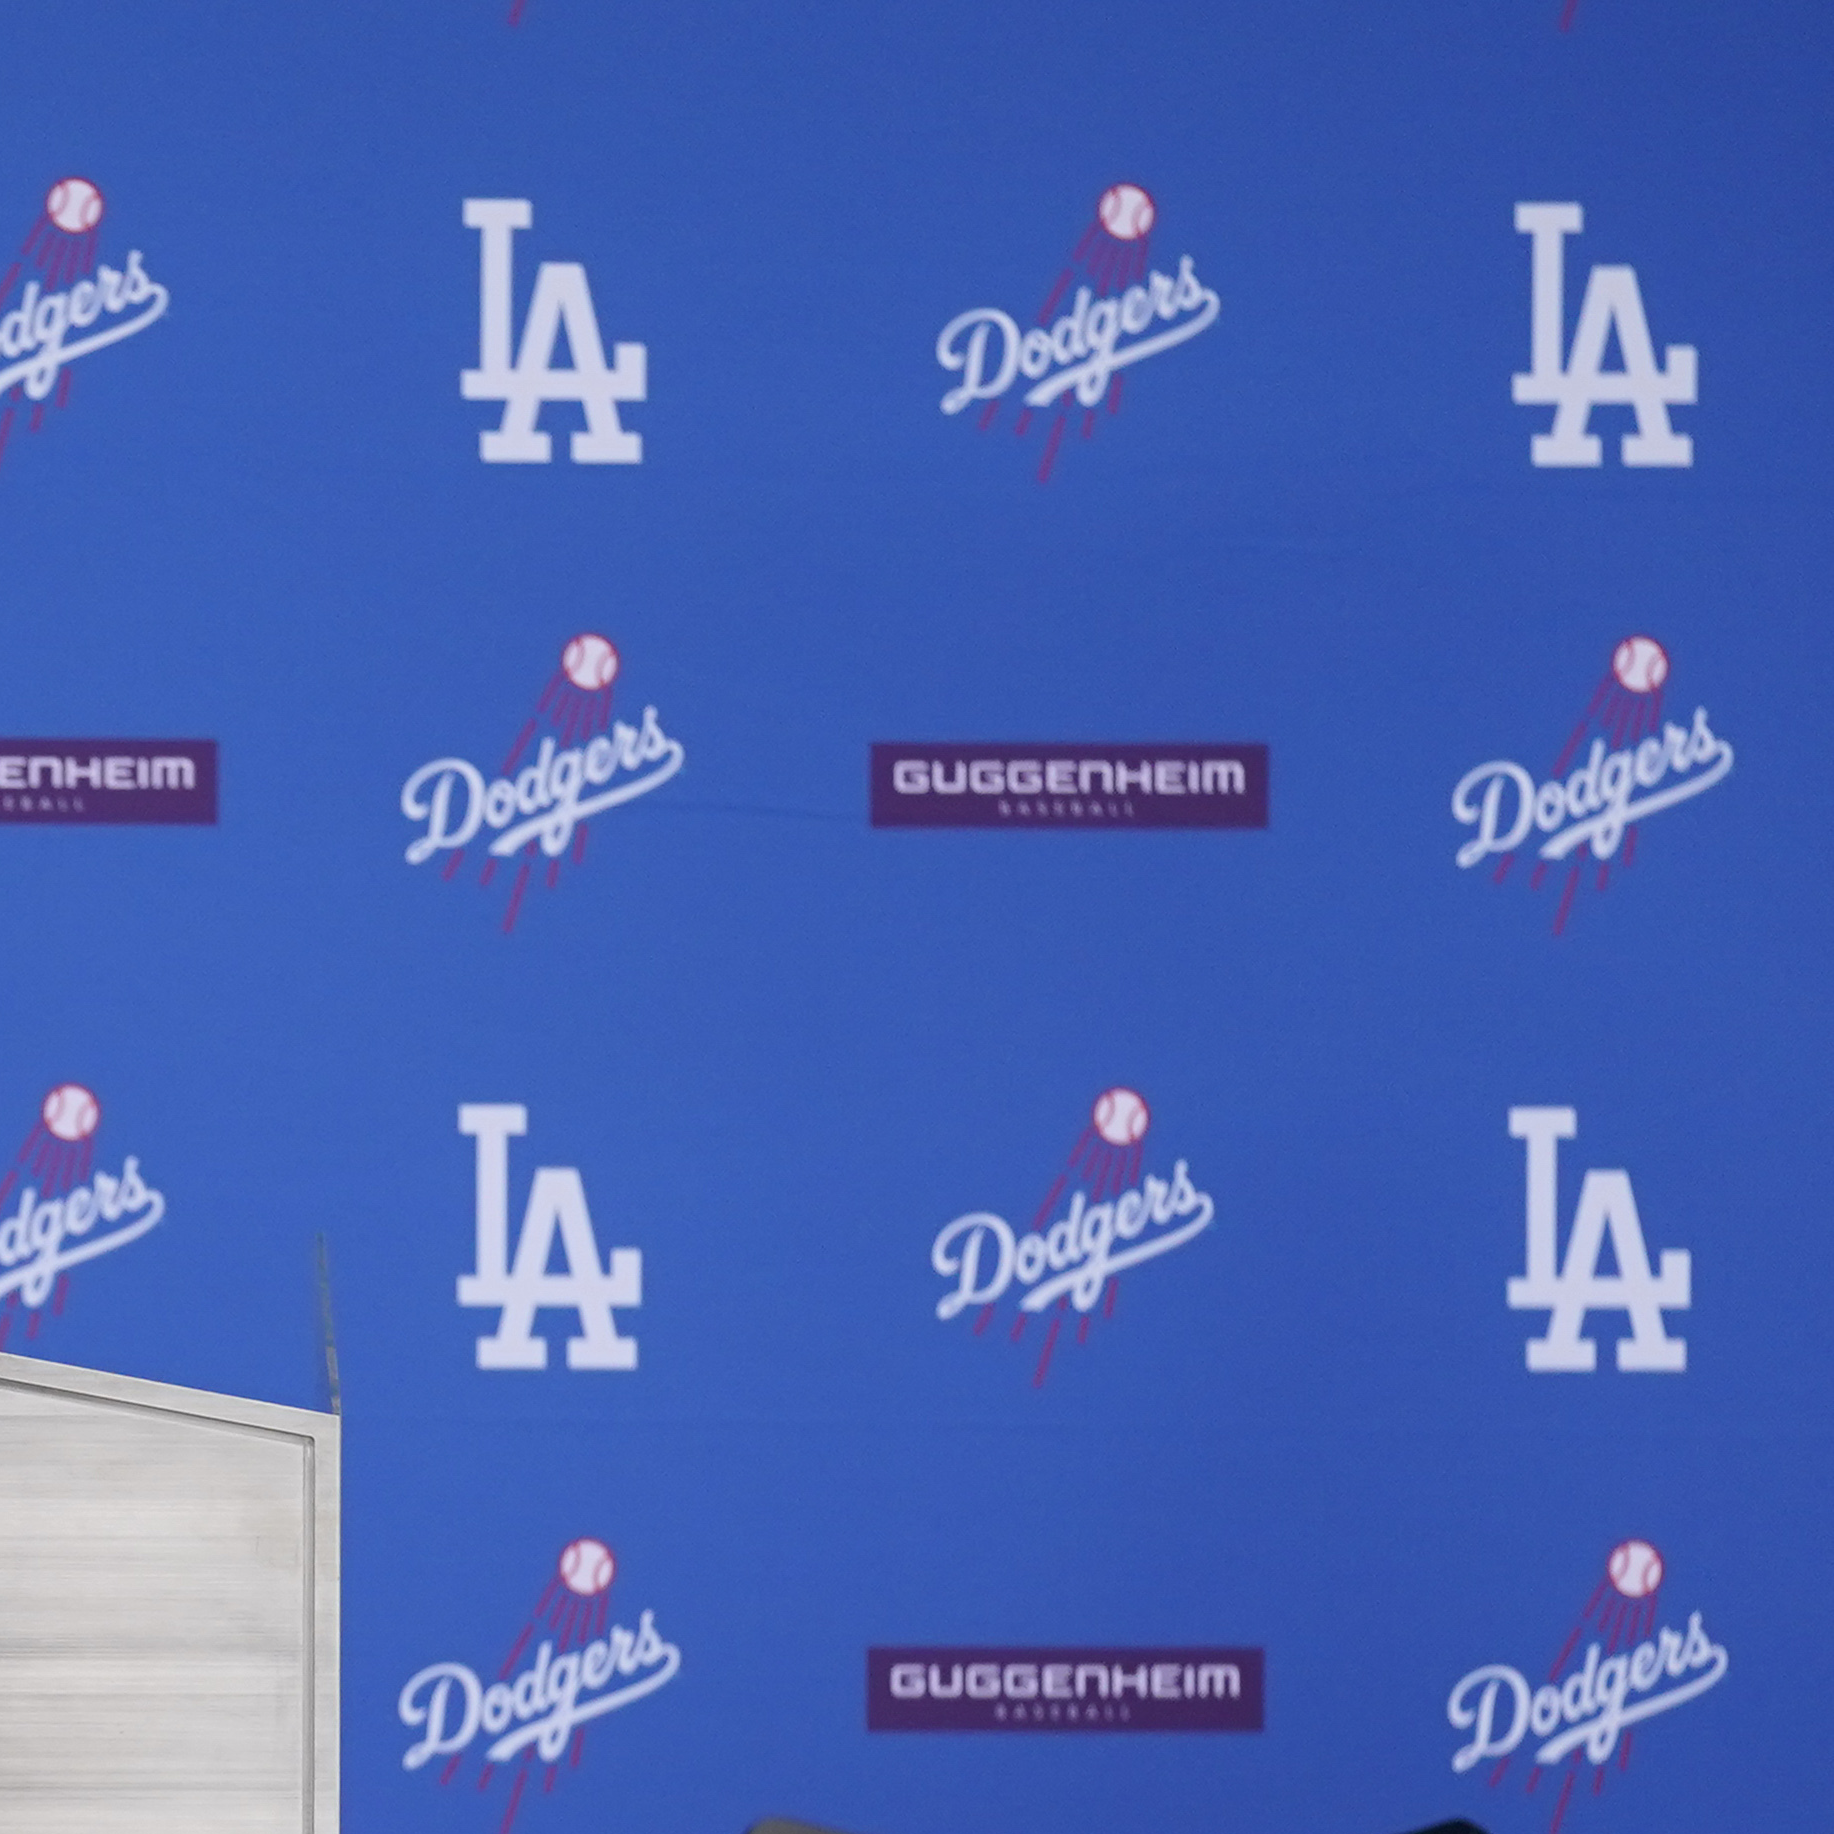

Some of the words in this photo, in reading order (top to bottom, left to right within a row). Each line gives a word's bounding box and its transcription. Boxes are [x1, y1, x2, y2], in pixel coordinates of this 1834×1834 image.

[461, 199, 646, 464] LA
[937, 256, 1219, 414] Dodgers
[1513, 203, 1697, 467] LA
[402, 707, 683, 863] Dodgers
[894, 761, 1244, 793] GUGGENHEIM
[1453, 709, 1732, 867] Dodgers
[457, 1104, 641, 1369] LA
[932, 1161, 1213, 1319] Dodgers
[1508, 1107, 1691, 1371] LA
[399, 1611, 679, 1768] Dodgers
[891, 1664, 1240, 1697] GUGGENHEIM
[1448, 1613, 1727, 1771] Dodgers
